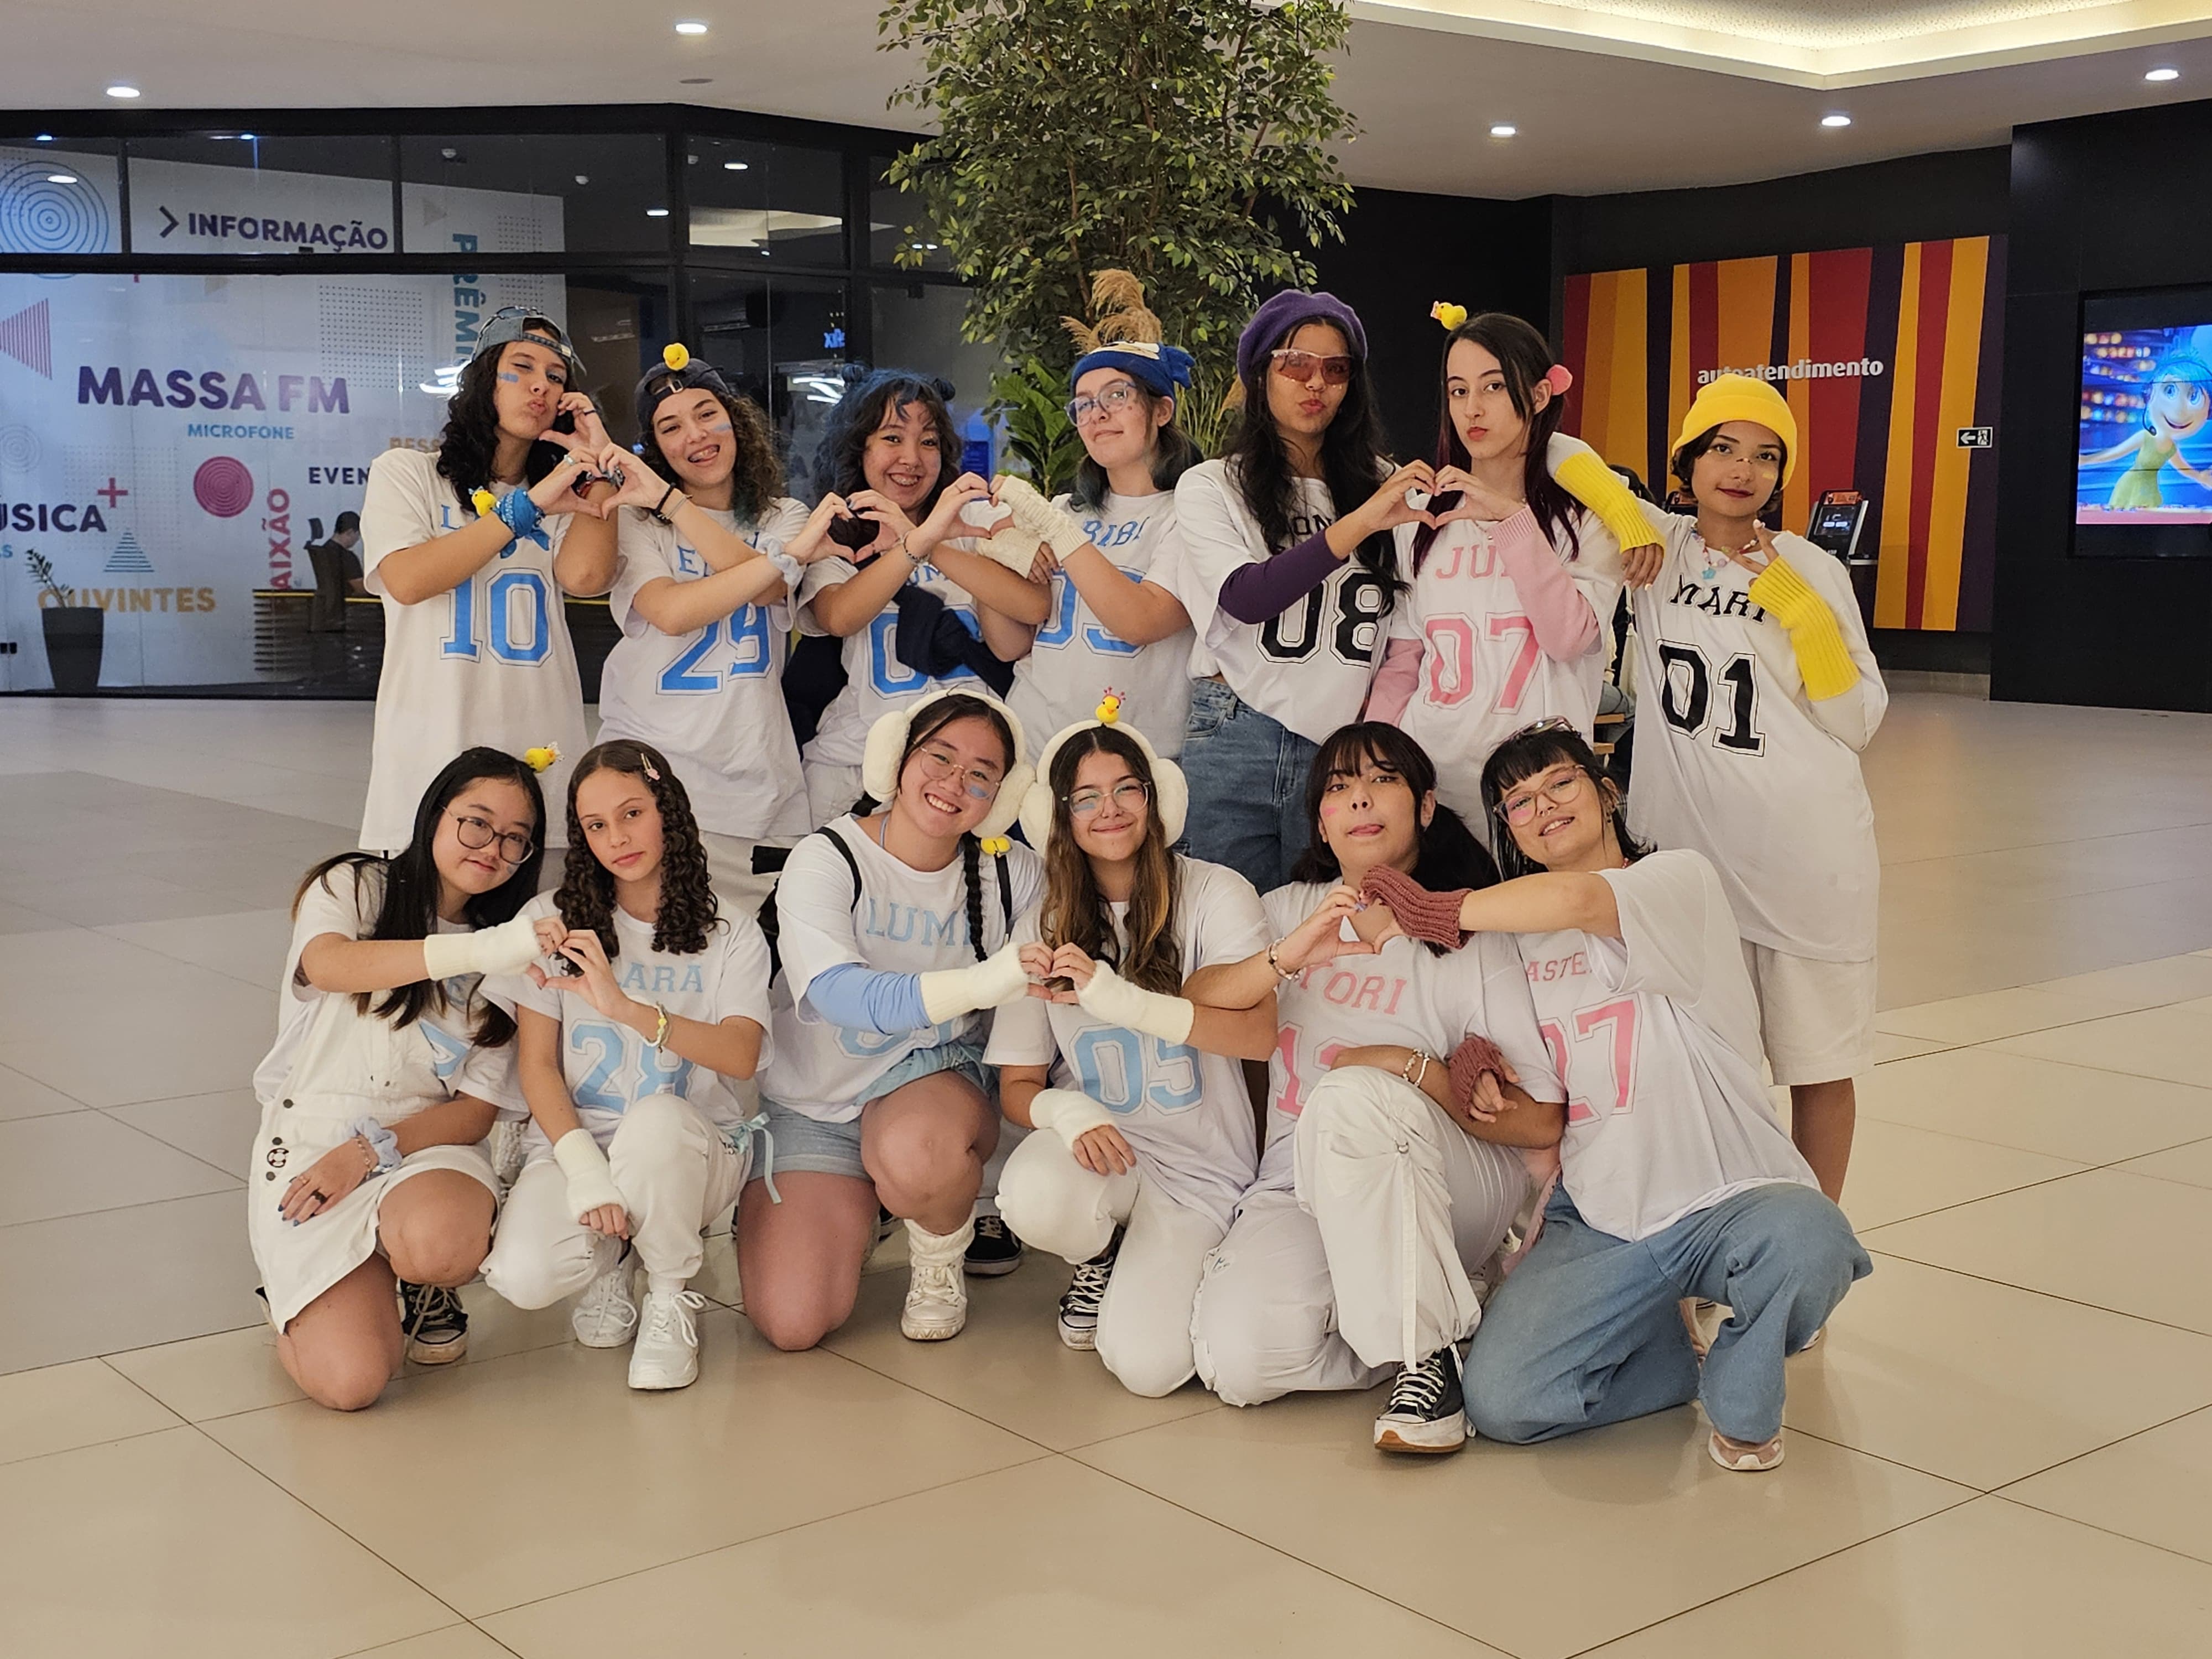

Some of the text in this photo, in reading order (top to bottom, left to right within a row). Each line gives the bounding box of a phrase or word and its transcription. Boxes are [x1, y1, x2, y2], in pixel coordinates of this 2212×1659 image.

[188, 212, 388, 251] INFORMAÇÃO
[452, 233, 486, 367] PRÊMI
[78, 366, 351, 414] MASSA FM
[187, 424, 295, 440] MICROFONE
[1434, 544, 1512, 579] JU
[439, 568, 552, 667] 10
[656, 602, 773, 695] 29
[1256, 567, 1391, 669] 08
[1423, 610, 1543, 714] 07
[1657, 639, 1766, 757] 01
[616, 961, 704, 993] ARA
[1526, 951, 1593, 982] ASTE
[1068, 1023, 1206, 1117] 05
